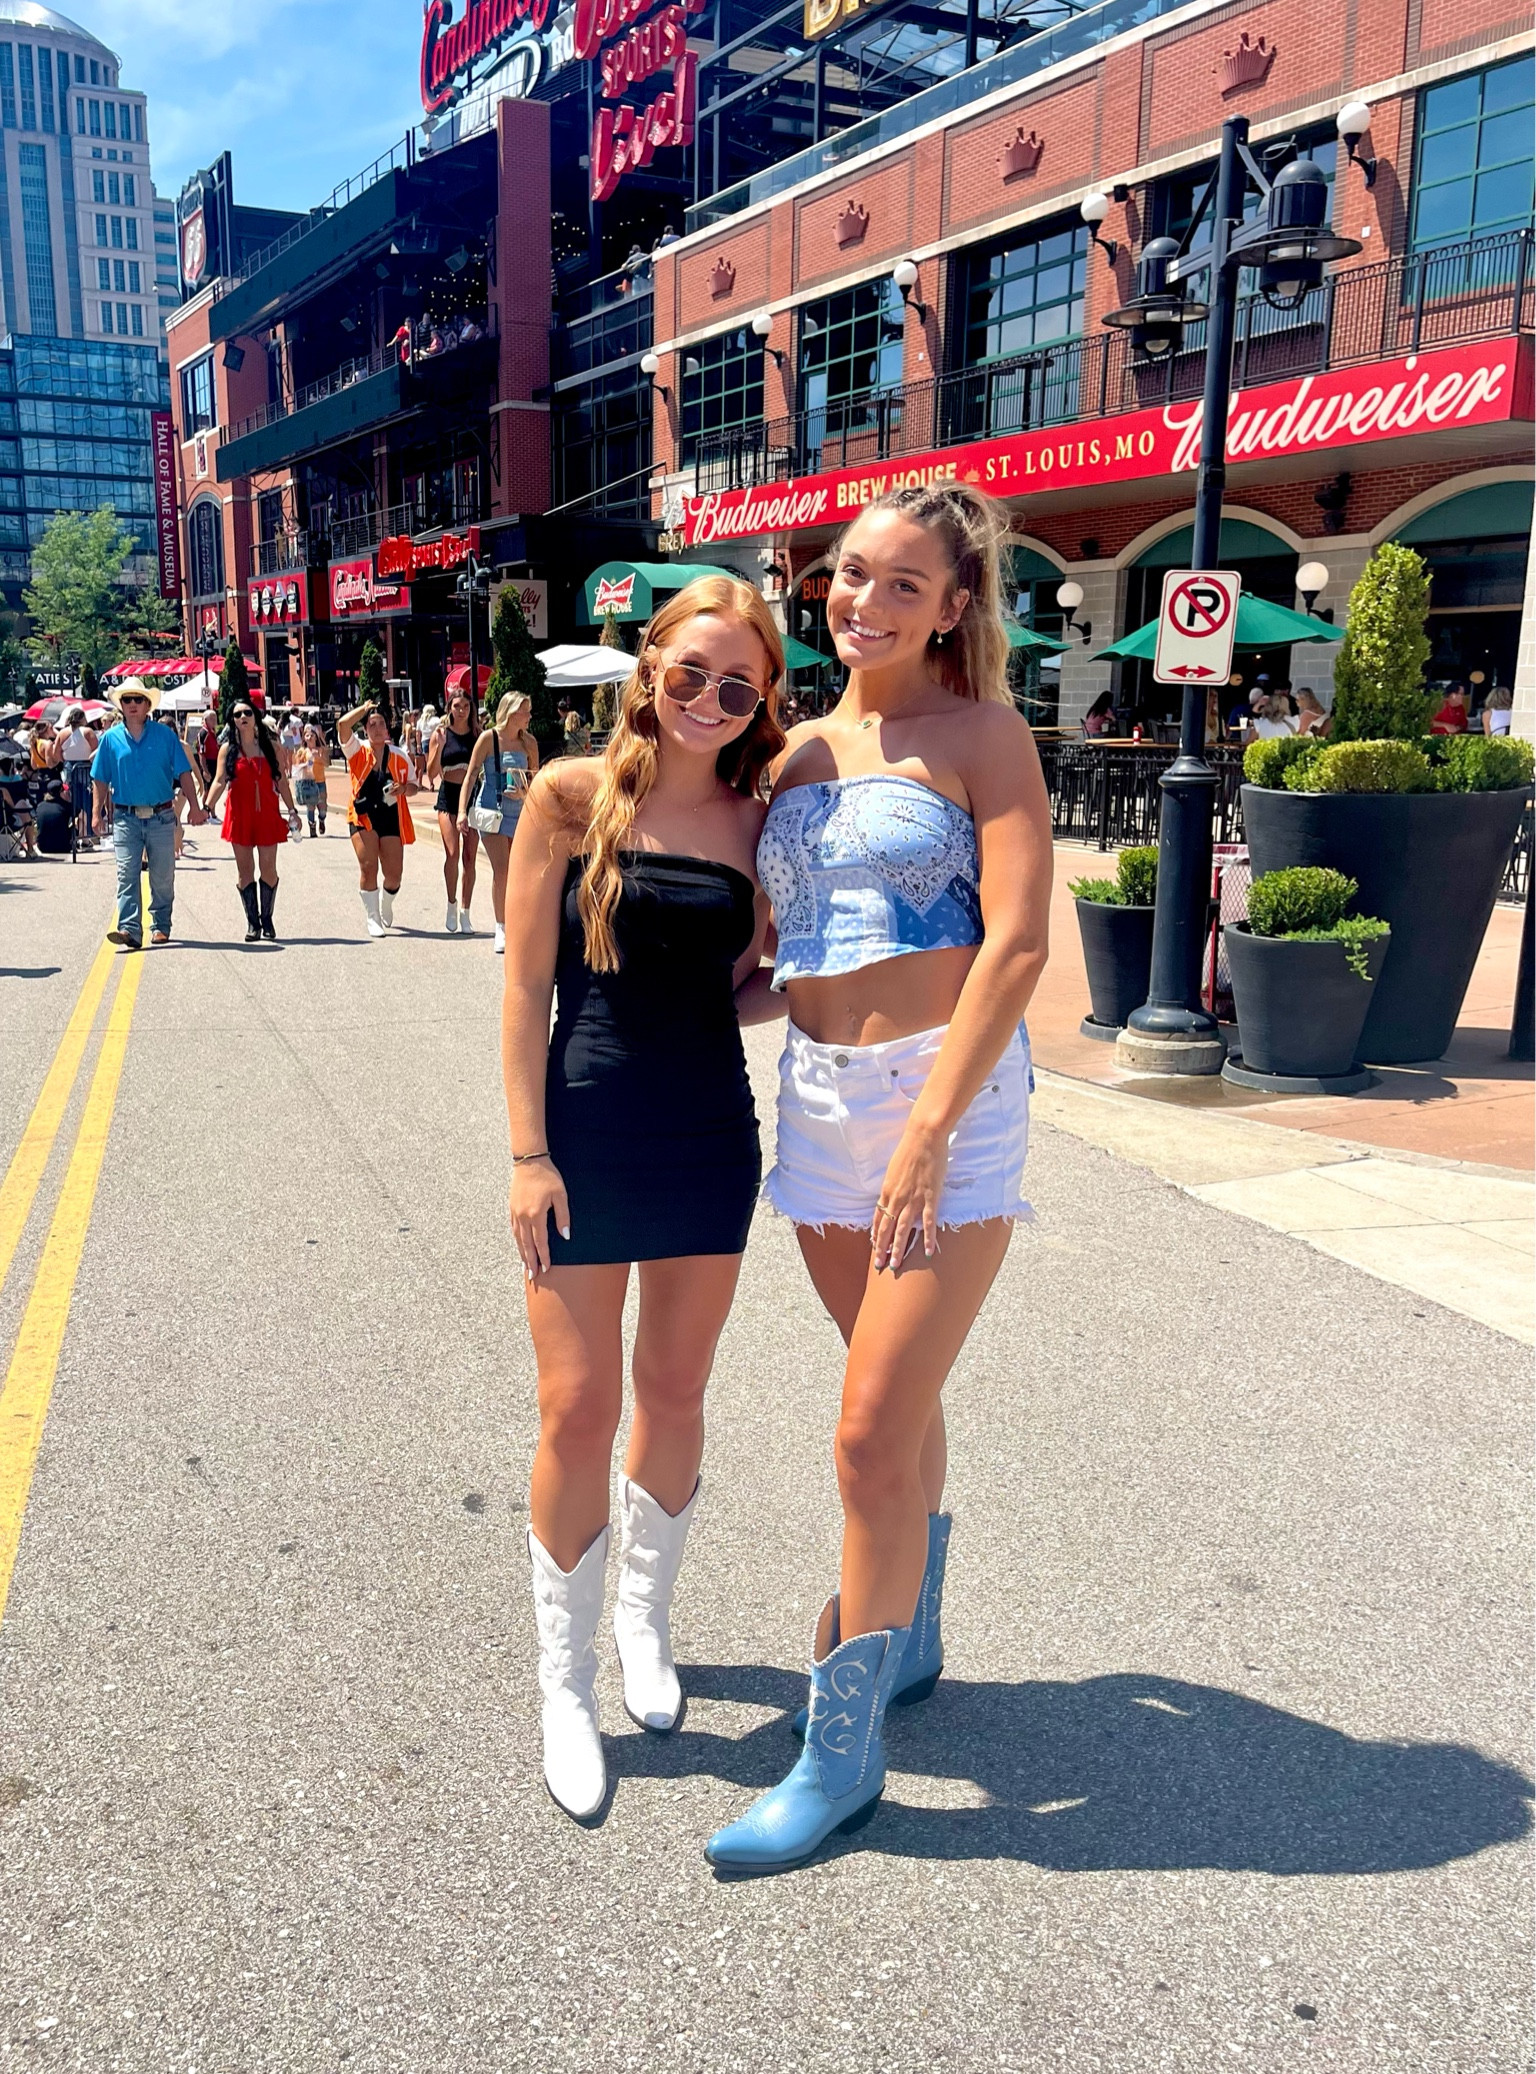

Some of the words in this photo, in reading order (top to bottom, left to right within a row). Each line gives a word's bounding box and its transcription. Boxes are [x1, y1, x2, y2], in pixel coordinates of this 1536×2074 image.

[601, 4, 687, 98] SPORTS
[157, 420, 169, 455] HALL
[1163, 356, 1507, 473] Budweiser
[159, 458, 171, 477] OF
[160, 480, 172, 516] FAME
[688, 481, 828, 544] Budweiser
[837, 474, 889, 508] BREW
[892, 462, 957, 490] HOUSE
[986, 457, 1018, 482] ST.
[162, 519, 174, 529] &
[163, 532, 176, 590] MUSEUM
